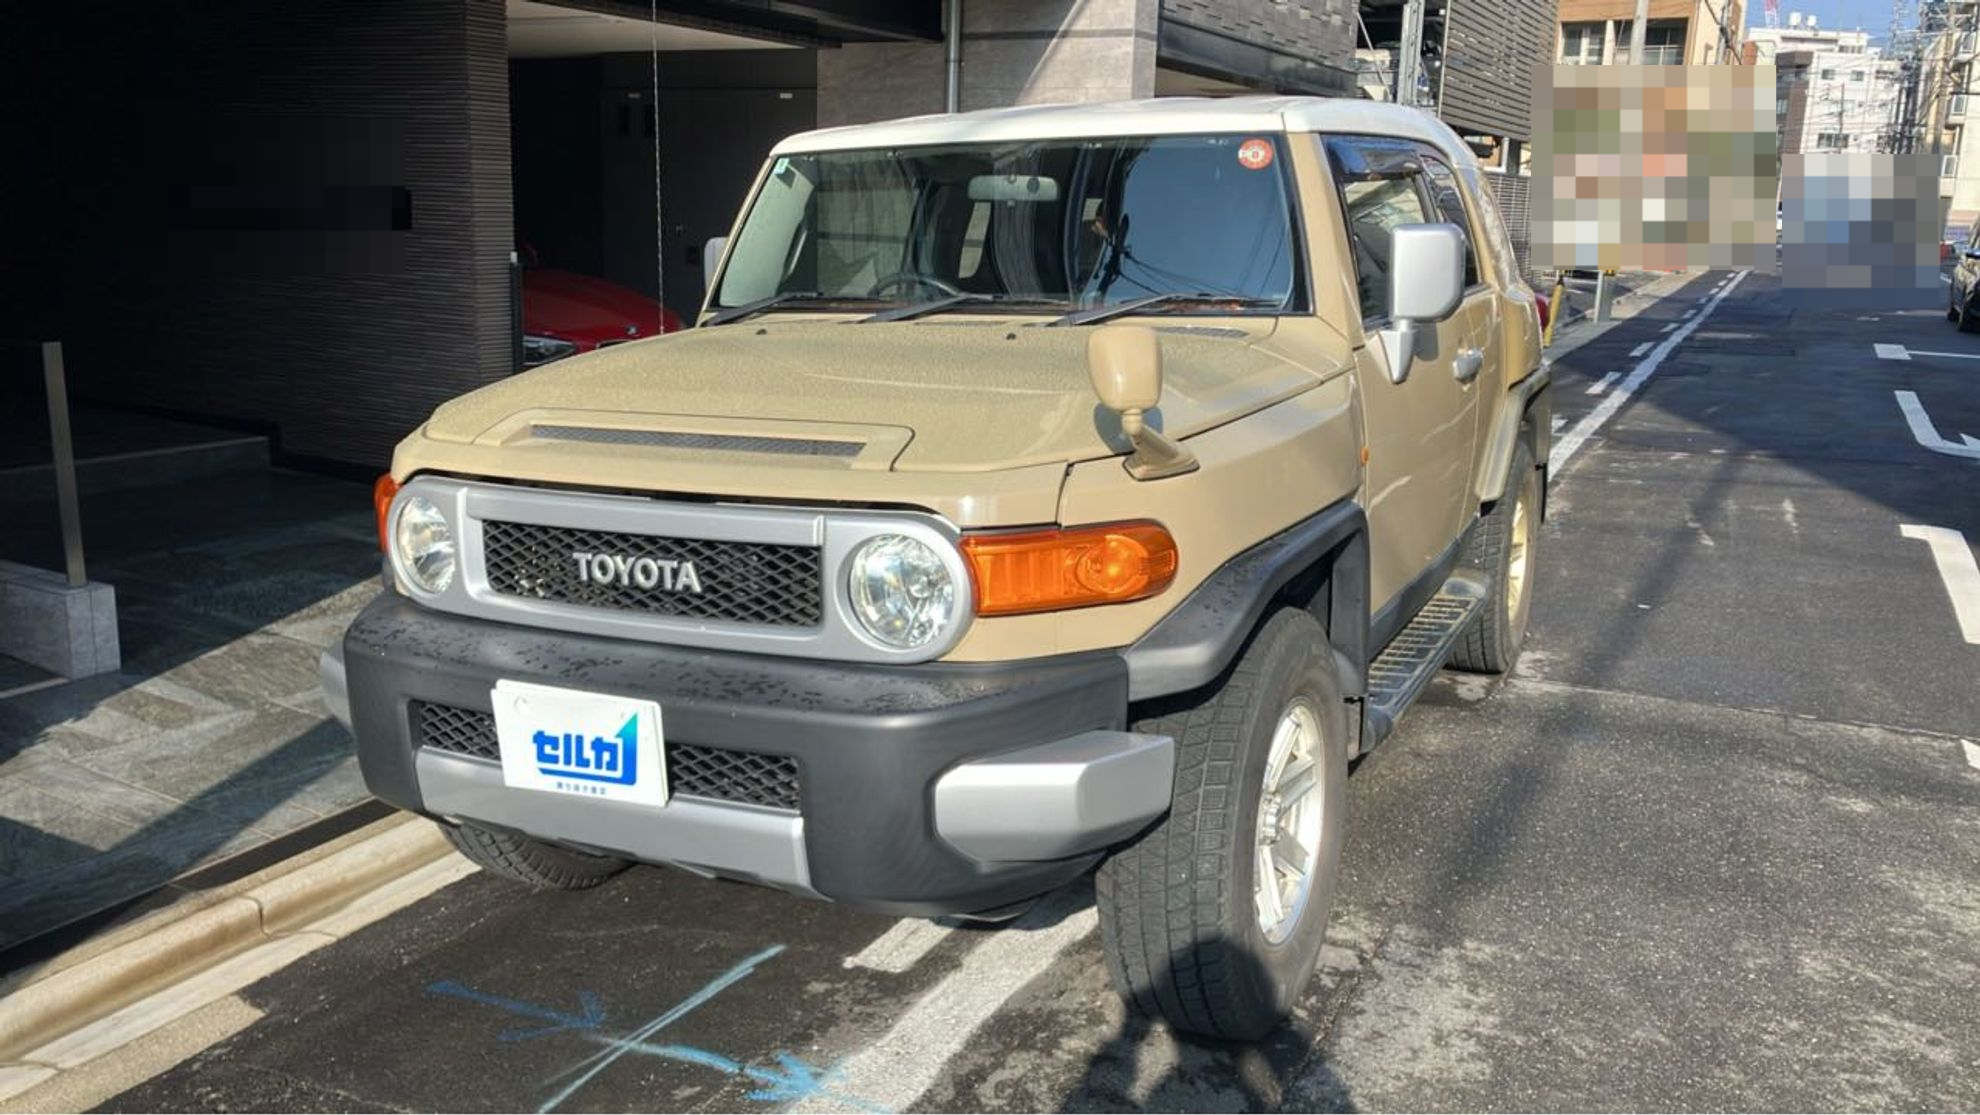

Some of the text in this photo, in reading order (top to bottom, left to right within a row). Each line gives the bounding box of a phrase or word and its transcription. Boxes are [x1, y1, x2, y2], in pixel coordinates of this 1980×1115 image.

[572, 552, 702, 593] TOYOTA
[532, 730, 619, 772] セルカ
